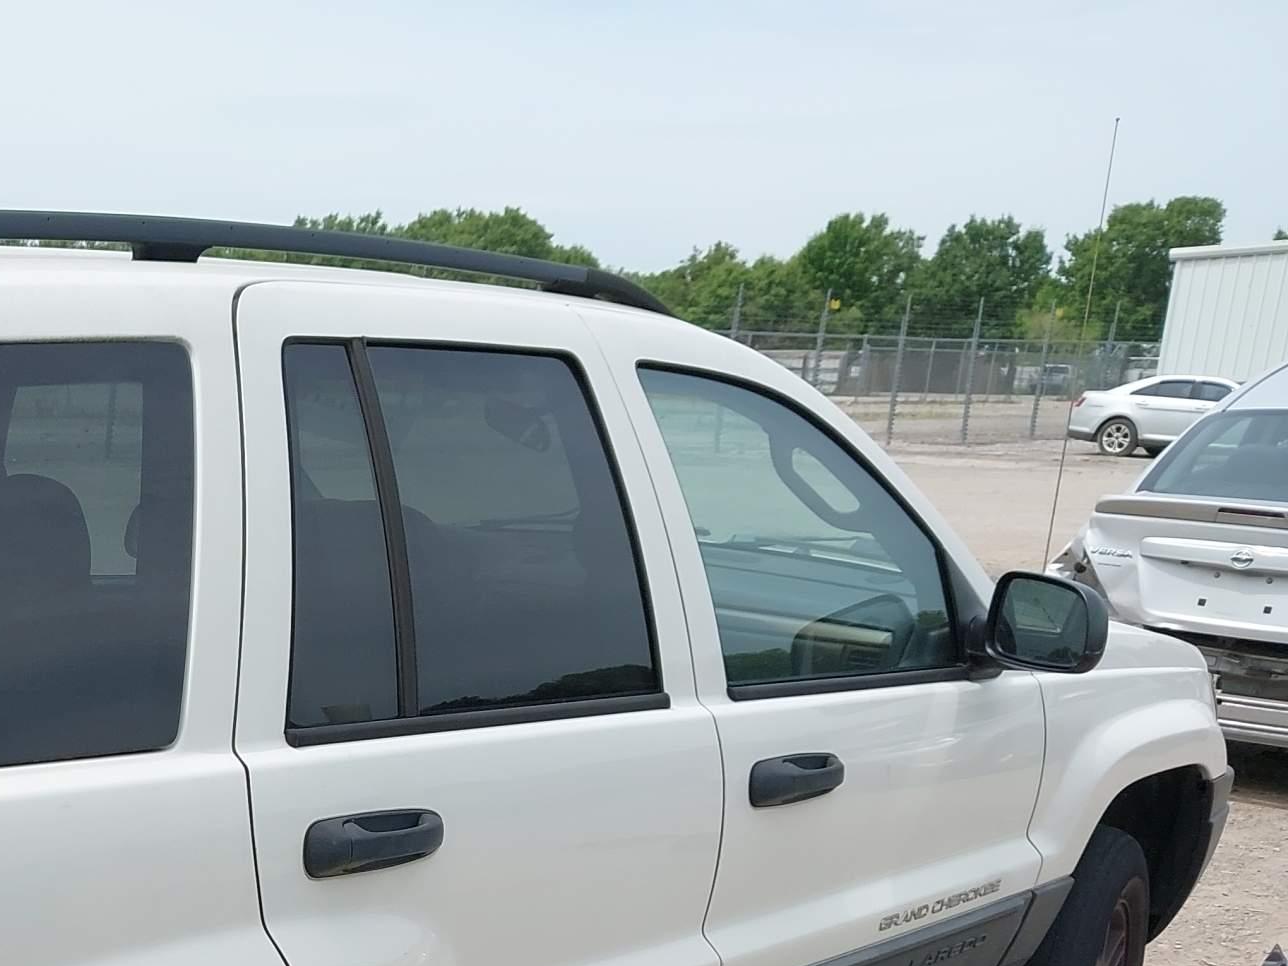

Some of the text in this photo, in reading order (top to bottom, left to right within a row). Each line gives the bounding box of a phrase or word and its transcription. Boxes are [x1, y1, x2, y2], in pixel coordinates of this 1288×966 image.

[1090, 548, 1133, 559] VERSA
[879, 880, 1001, 931] GRAND CHEROKEE
